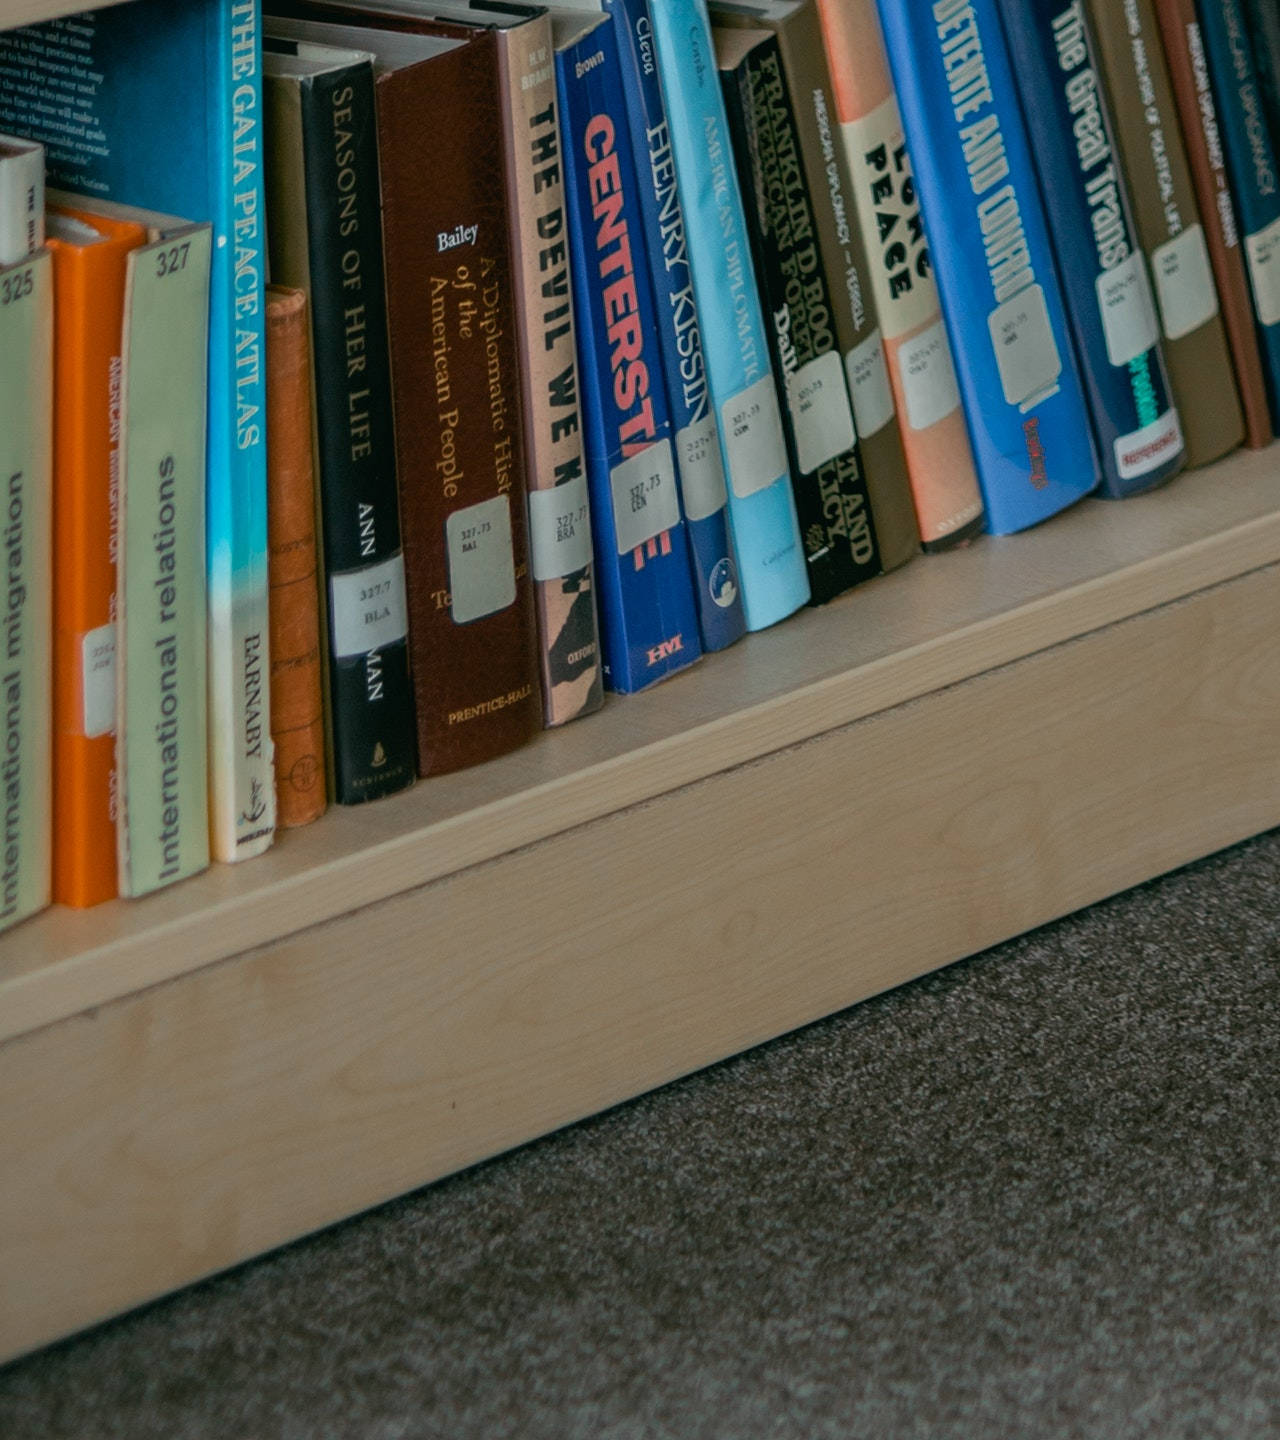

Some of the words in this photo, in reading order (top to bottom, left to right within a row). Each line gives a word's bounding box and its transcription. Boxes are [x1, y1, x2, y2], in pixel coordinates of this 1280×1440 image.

[232, 85, 256, 184] GAIA
[155, 248, 191, 277] 327
[233, 189, 259, 321] PEACE
[436, 223, 478, 253] Bailey
[235, 328, 260, 451] ATLAS
[155, 452, 178, 617] relations
[157, 626, 184, 880] International
